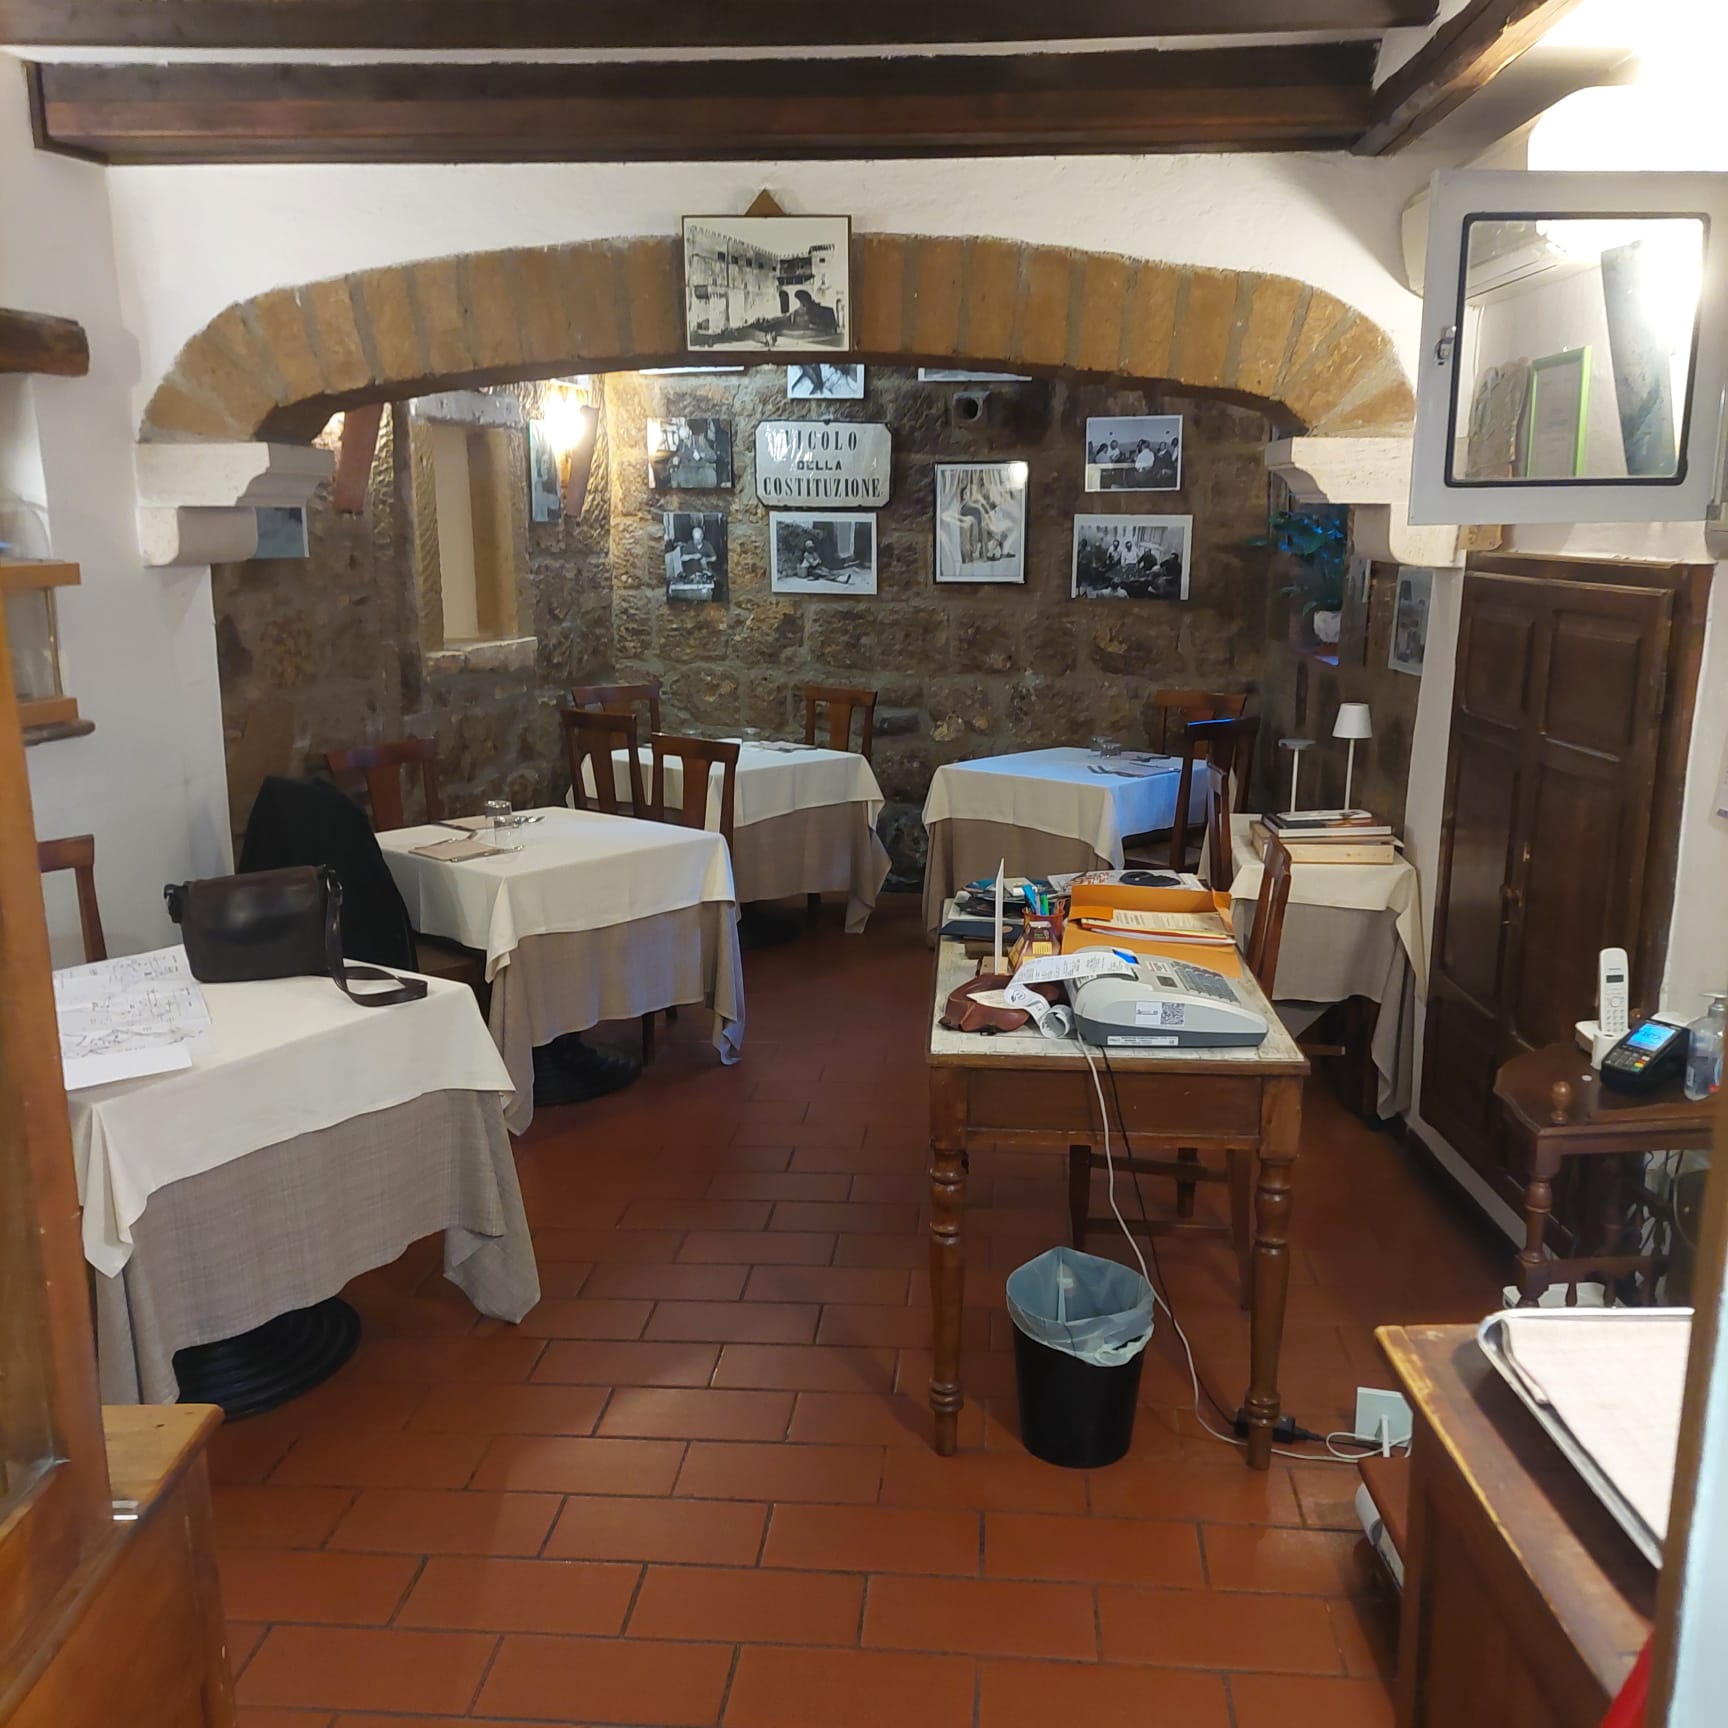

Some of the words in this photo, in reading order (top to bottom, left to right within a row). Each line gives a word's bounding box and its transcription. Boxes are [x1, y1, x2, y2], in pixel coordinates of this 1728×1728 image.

[785, 430, 858, 451] VICOLO
[796, 460, 842, 471] DELLA
[763, 477, 881, 498] COSTITUZIONE
